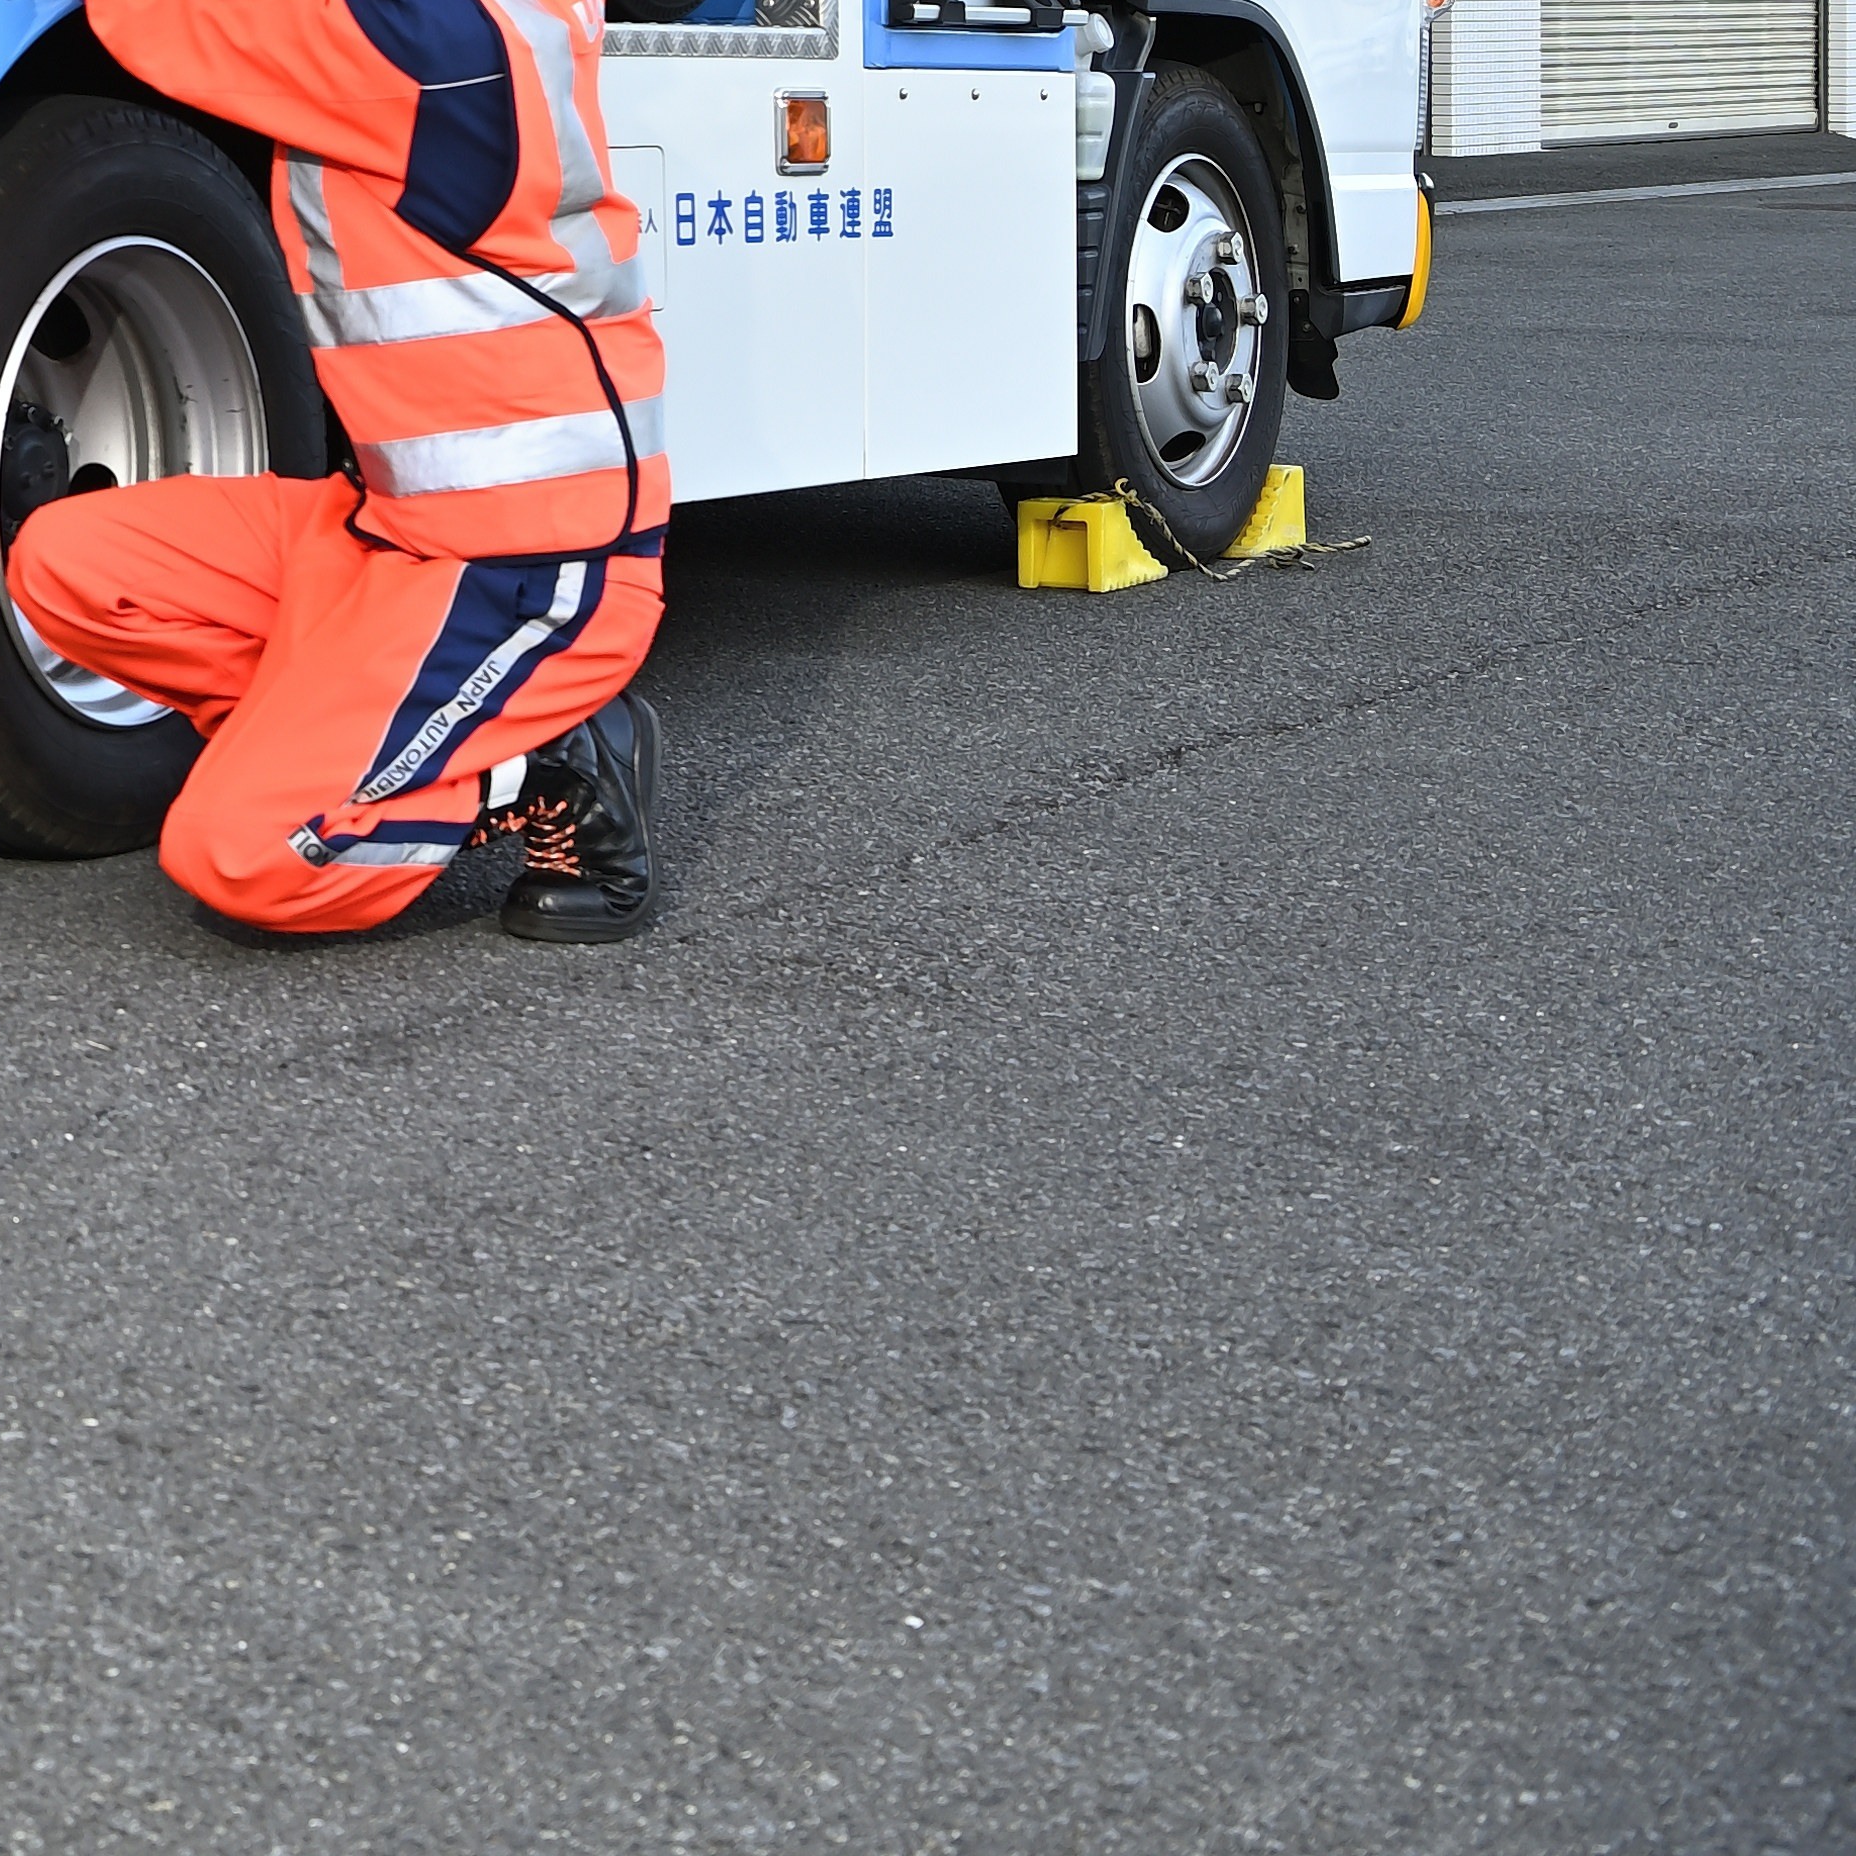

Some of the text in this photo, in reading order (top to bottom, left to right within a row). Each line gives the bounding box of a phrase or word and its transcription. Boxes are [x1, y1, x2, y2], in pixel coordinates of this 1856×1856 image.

[675, 187, 895, 246] 日本自動車連盟
